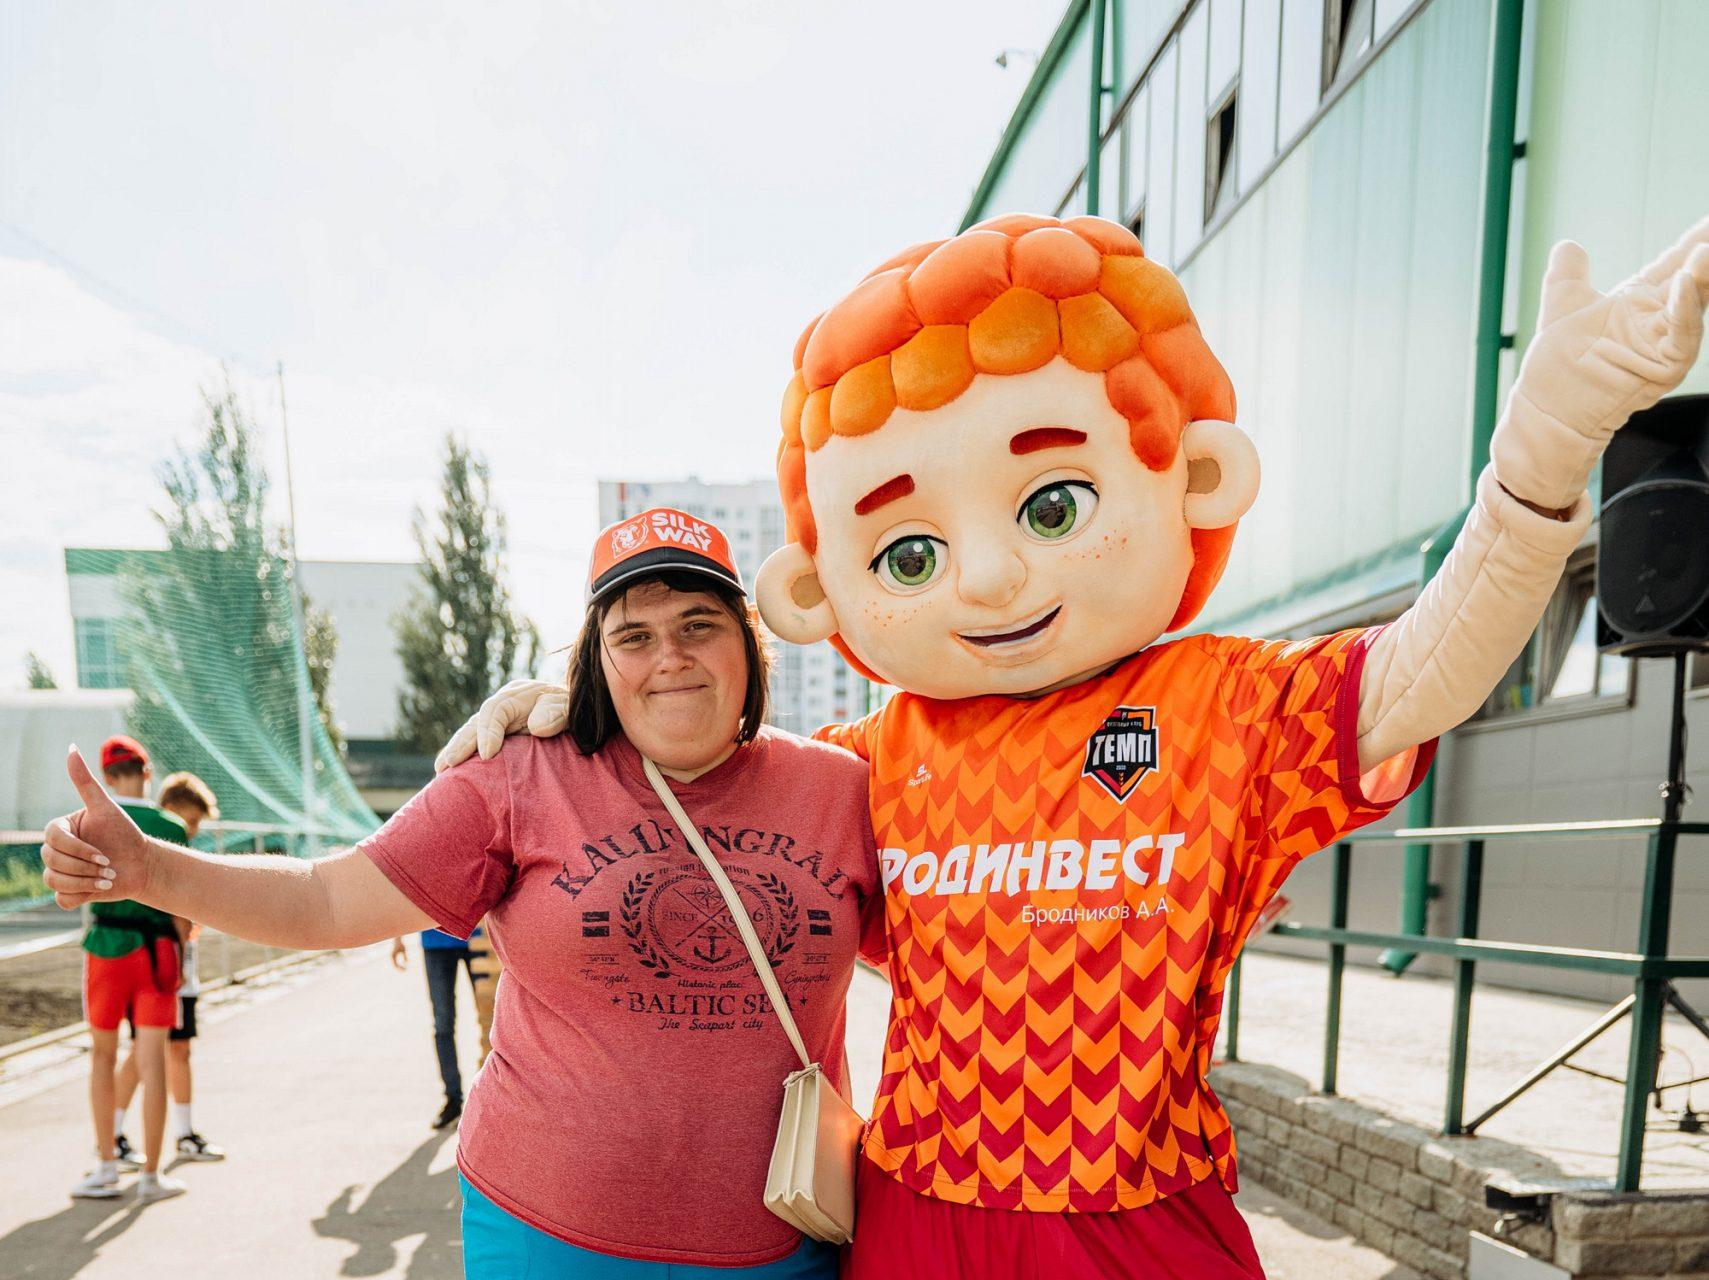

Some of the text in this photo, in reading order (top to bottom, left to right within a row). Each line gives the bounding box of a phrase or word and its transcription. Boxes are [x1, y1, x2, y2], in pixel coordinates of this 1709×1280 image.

[651, 512, 712, 539] SILK
[653, 527, 712, 552] WAY
[1092, 733, 1152, 766] ТЕМП
[551, 819, 850, 901] KALINNGRAD
[877, 832, 1185, 897] РОДИНВЕСТ
[663, 910, 698, 922] SINCE
[1021, 897, 1175, 927] Бродников А.А.
[627, 992, 735, 1016] BALTIC
[657, 1016, 680, 1030] The
[743, 1019, 764, 1030] city
